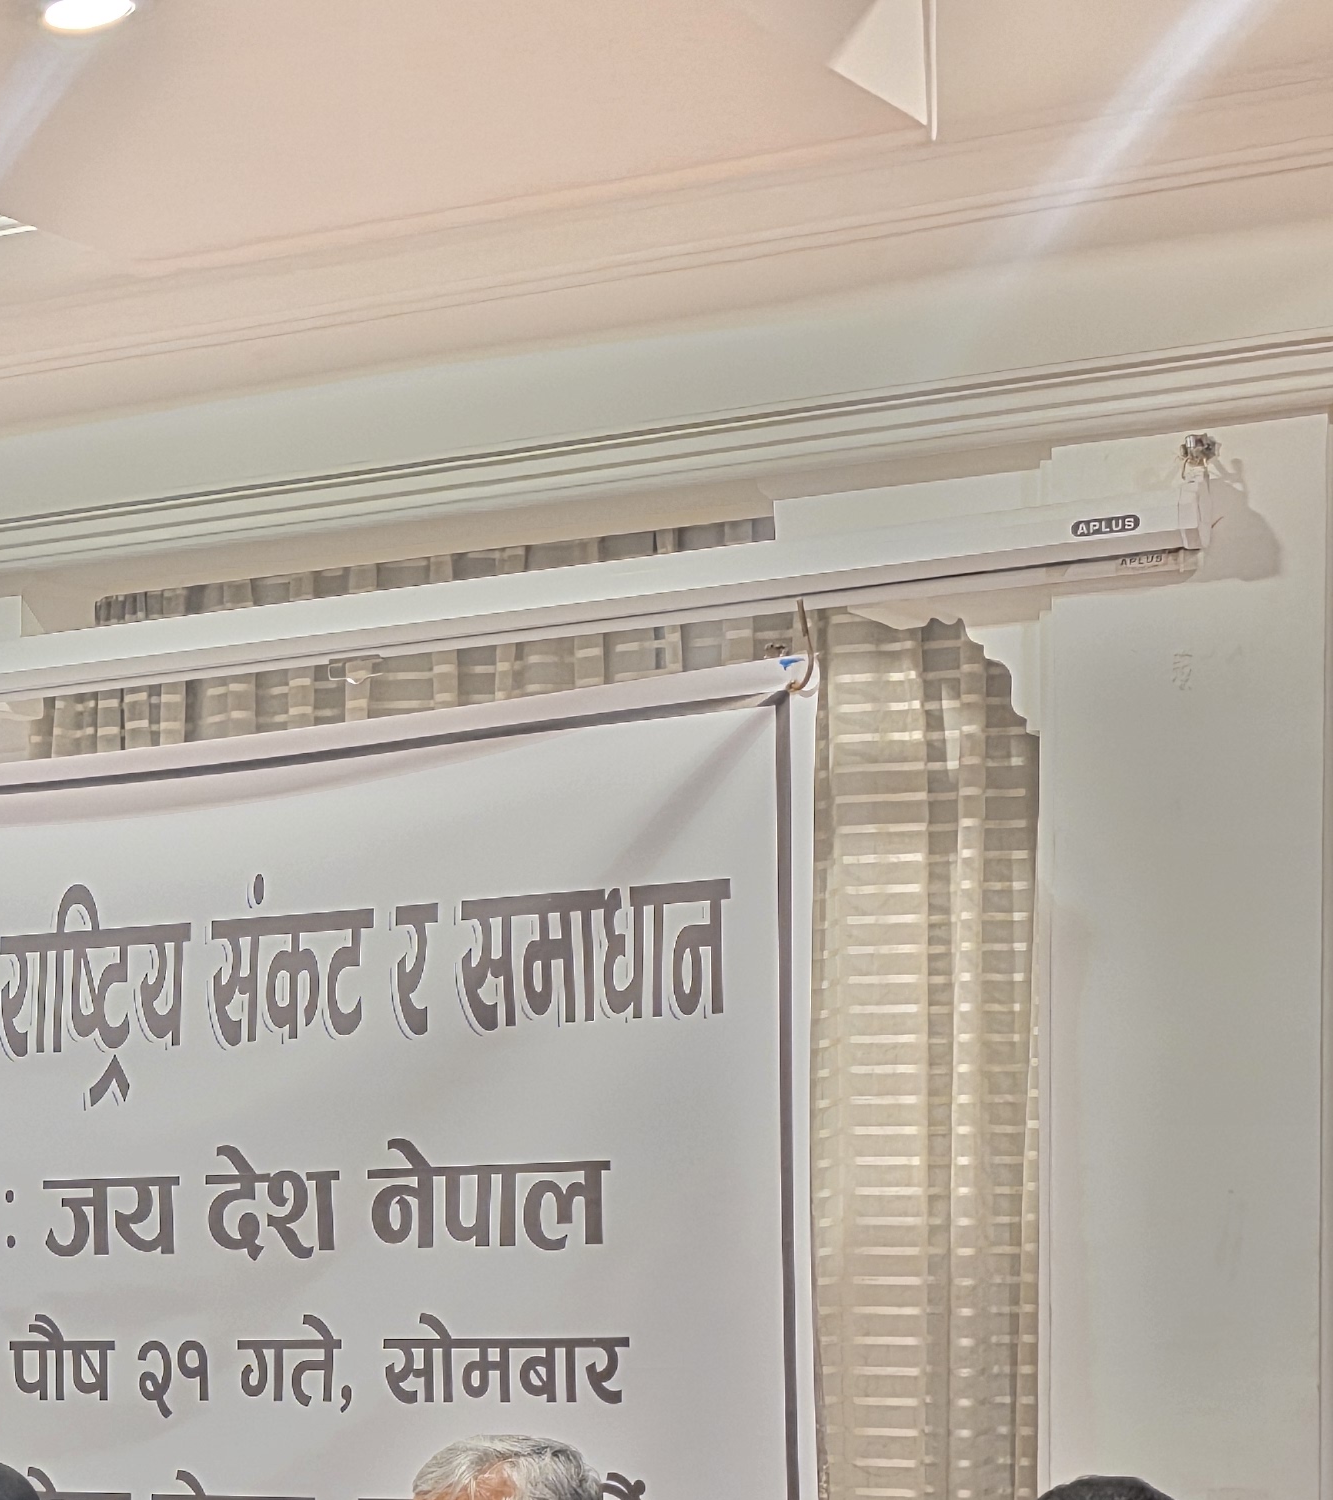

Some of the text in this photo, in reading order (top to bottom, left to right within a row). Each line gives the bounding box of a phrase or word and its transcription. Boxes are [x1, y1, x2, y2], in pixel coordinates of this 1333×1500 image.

[1076, 516, 1135, 536] APLUS
[207, 872, 375, 1048] संकट
[392, 902, 439, 1037] र
[457, 877, 732, 1033] समाधान
[42, 1176, 181, 1258] जय
[204, 1144, 340, 1263] देश
[366, 1137, 612, 1251] नेपाल
[8, 1313, 116, 1402] पौष
[137, 1340, 210, 1419] २१
[236, 1313, 353, 1415] गते,
[382, 1312, 631, 1405] सोमबार
